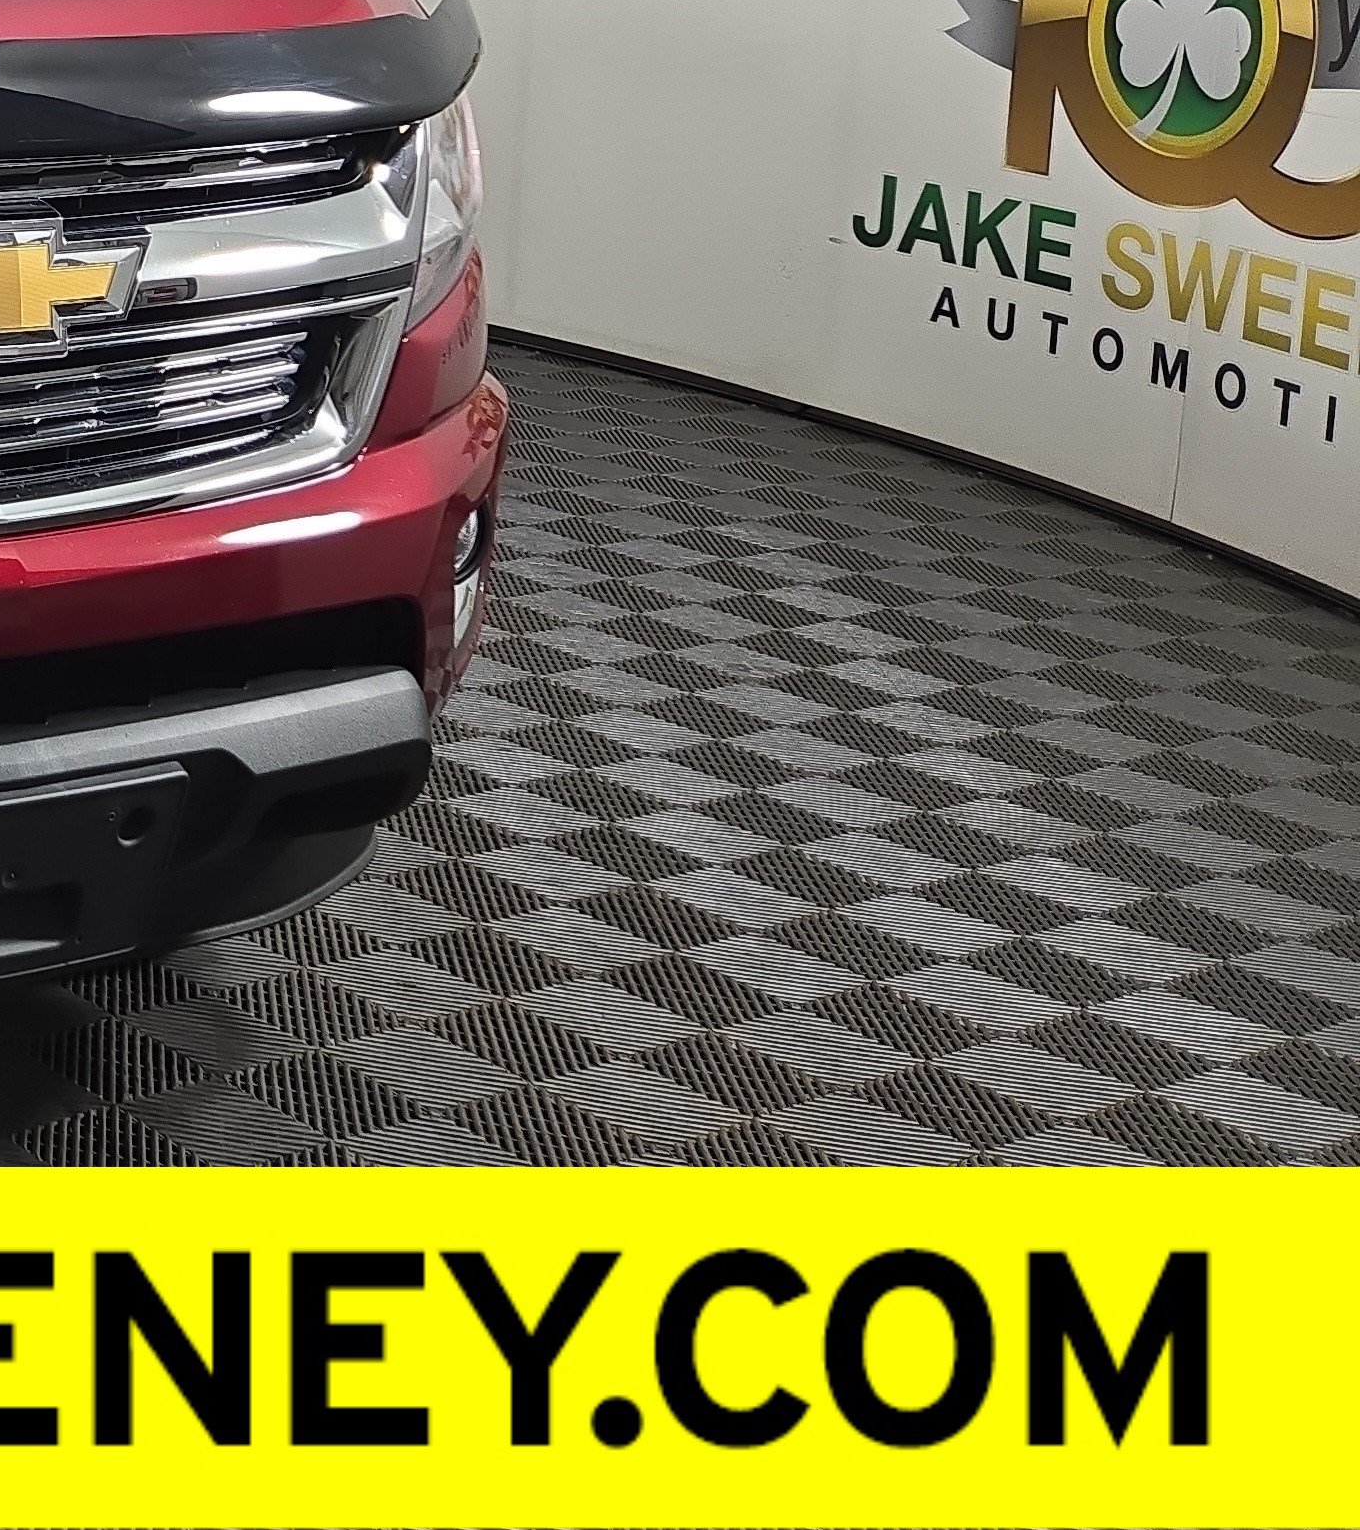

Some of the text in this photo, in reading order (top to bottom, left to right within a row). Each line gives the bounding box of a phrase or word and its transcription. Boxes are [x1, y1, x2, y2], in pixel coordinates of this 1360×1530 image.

[852, 174, 1360, 376] JAKE SWEE
[930, 286, 1339, 443] AUTOMOTI
